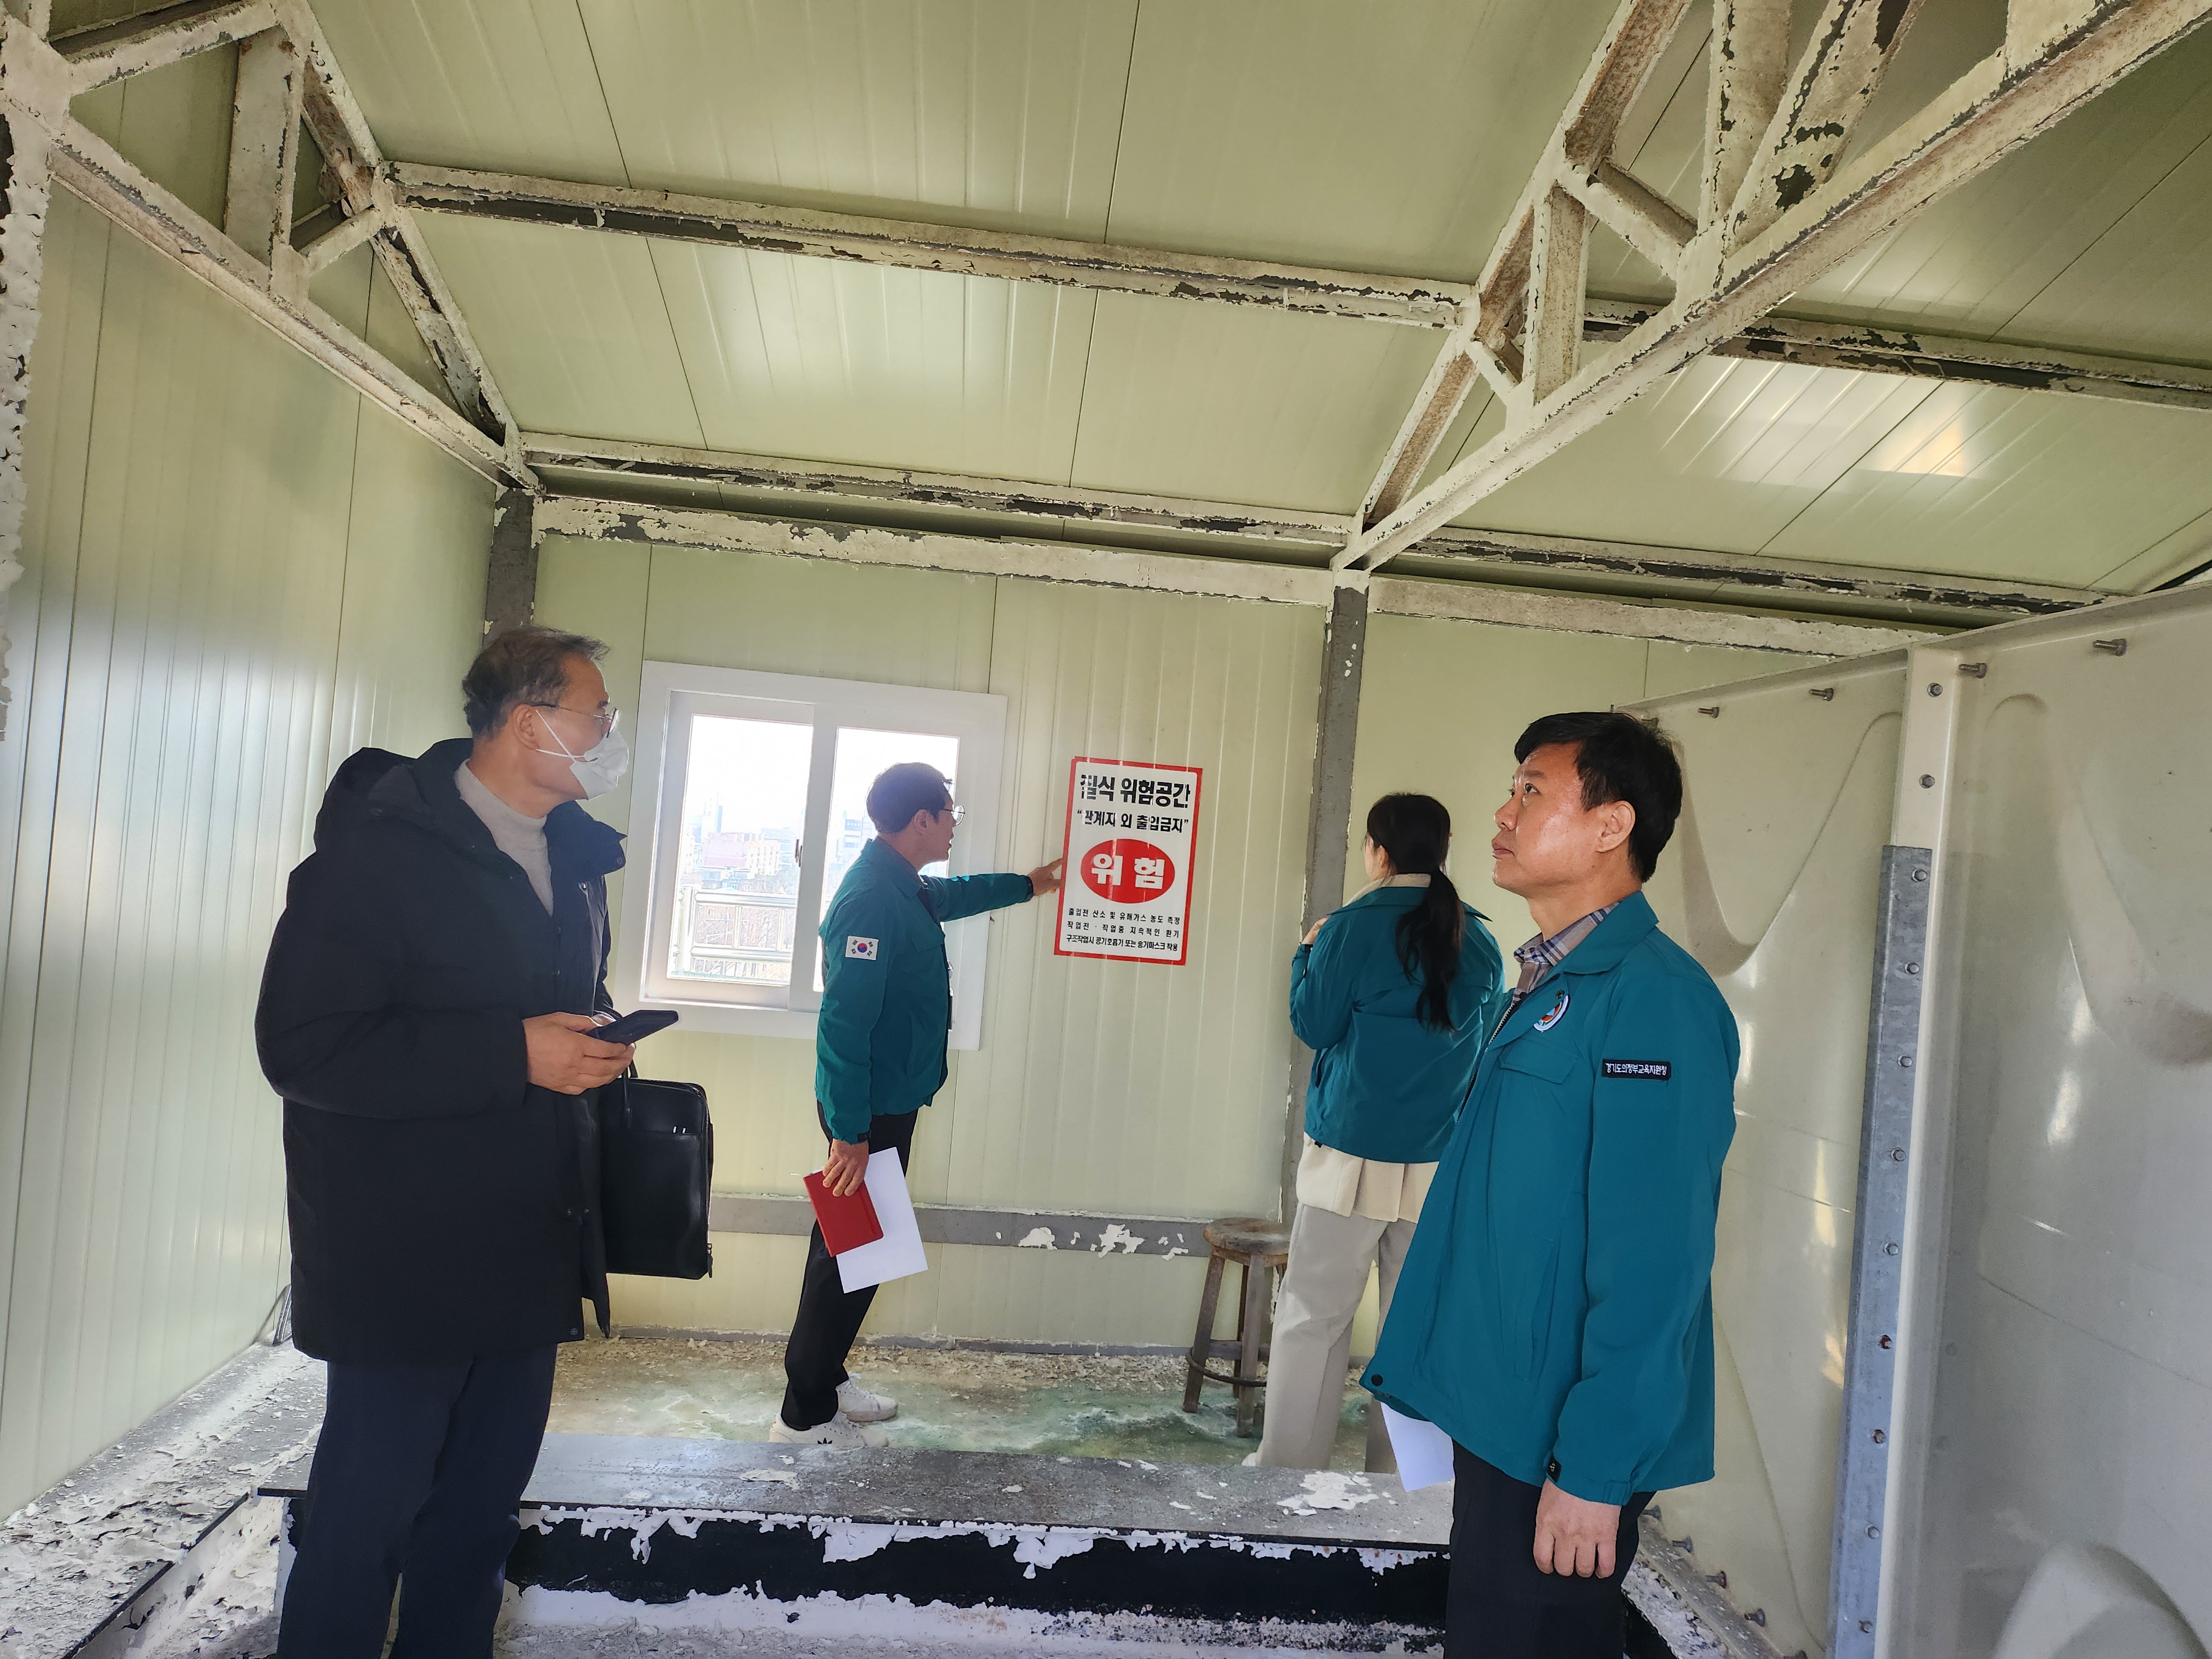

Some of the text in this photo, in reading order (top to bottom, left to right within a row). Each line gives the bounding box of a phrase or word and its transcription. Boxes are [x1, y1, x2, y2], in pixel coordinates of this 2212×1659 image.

[1080, 775, 1190, 808] 질식 위험공간
[1120, 813, 1132, 828] 외
[1093, 910, 1105, 919] 산소
[1110, 911, 1115, 920] 및
[1120, 912, 1146, 922] 유해가스
[1067, 921, 1089, 930] 작업전
[1102, 924, 1124, 933] 작업중
[1130, 926, 1160, 936] 지속적인
[1166, 930, 1179, 938] 환기
[1066, 935, 1094, 944] 구조작업시
[1095, 937, 1124, 947] 공기호흡기
[1125, 940, 1136, 948] 또는
